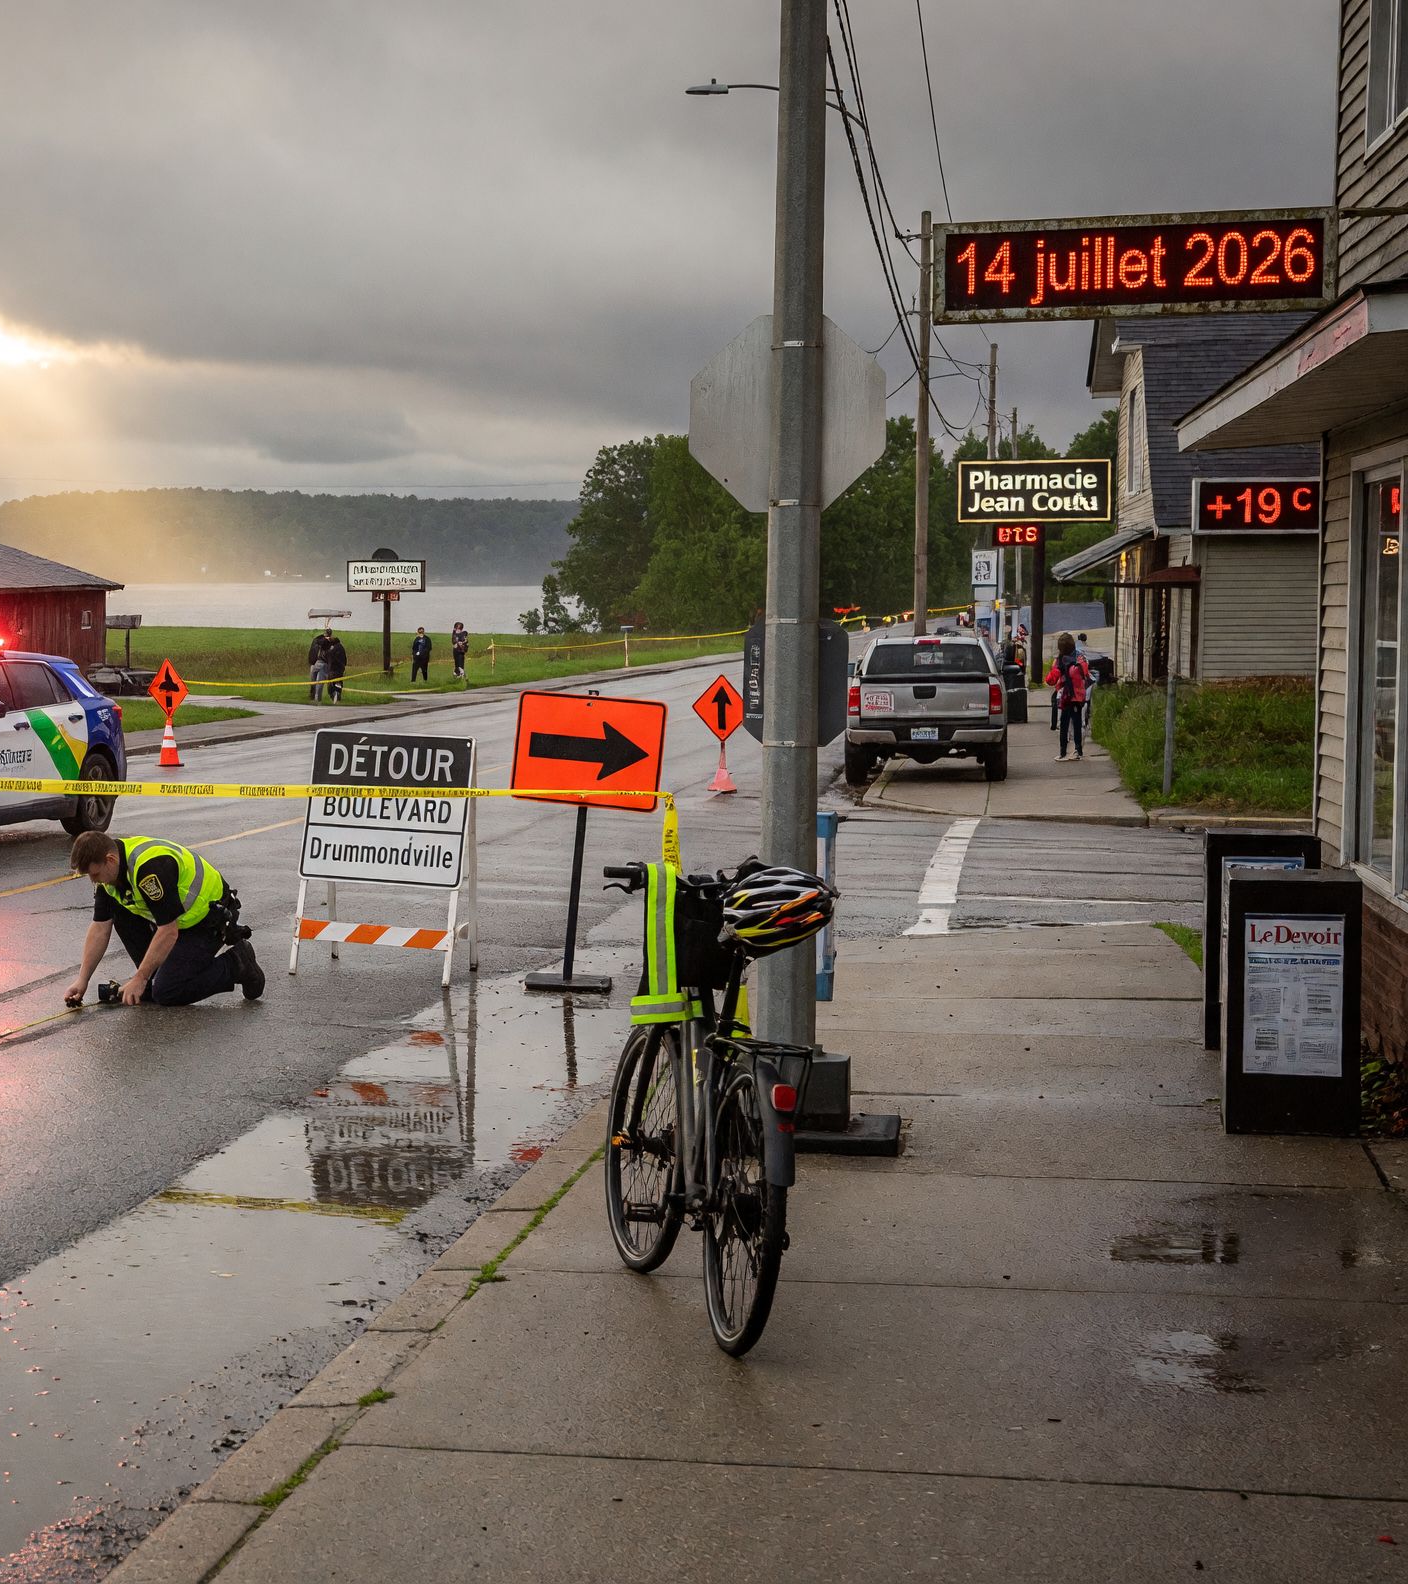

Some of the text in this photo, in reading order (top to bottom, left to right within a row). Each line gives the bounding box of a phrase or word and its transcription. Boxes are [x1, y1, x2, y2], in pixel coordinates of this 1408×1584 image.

[957, 228, 1315, 305] 14 juillet 2026
[969, 468, 1098, 490] Pharmacie
[968, 492, 1025, 512] Jean
[1206, 487, 1281, 524] +19
[328, 736, 455, 782] DÉTOUR
[323, 796, 452, 824] BOULEVARD
